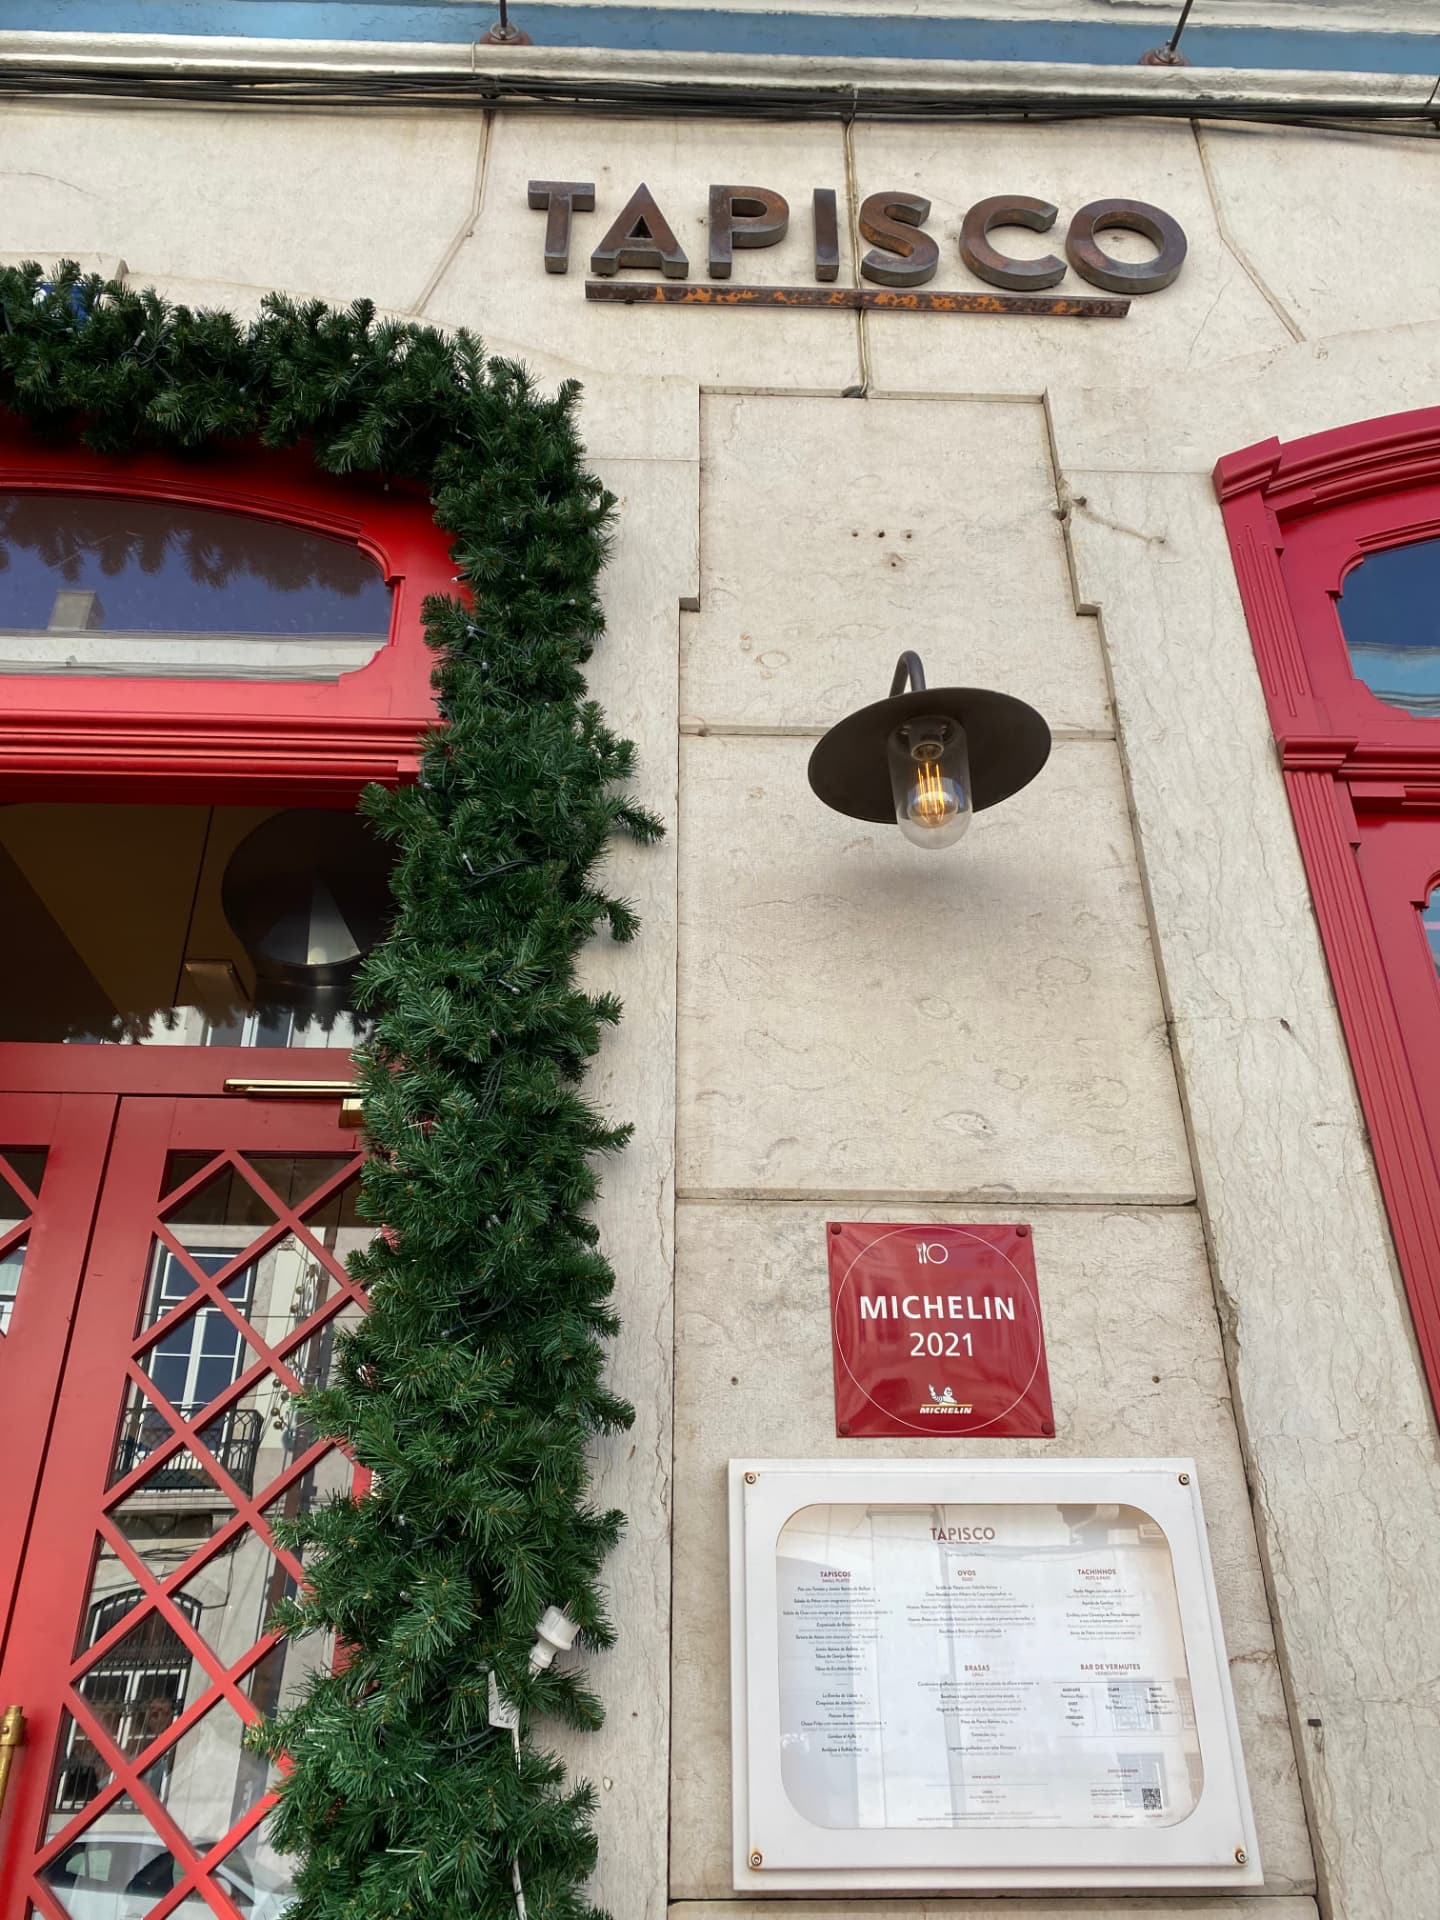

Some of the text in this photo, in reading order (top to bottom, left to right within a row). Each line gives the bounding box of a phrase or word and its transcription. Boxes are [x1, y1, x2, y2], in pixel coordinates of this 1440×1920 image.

[527, 179, 1188, 294] TAPISCO
[859, 1295, 1016, 1321] MICHELIN
[909, 1332, 973, 1357] 2021
[919, 1406, 973, 1415] MICHELIN
[930, 1527, 995, 1541] TAPISCO
[819, 1570, 852, 1578] TAPISCOS
[957, 1569, 977, 1577] OVOS
[1077, 1568, 1117, 1576] TACHINHOS
[964, 1664, 990, 1672] BRASAS
[1080, 1663, 1141, 1671] BAR DE VERMUTES
